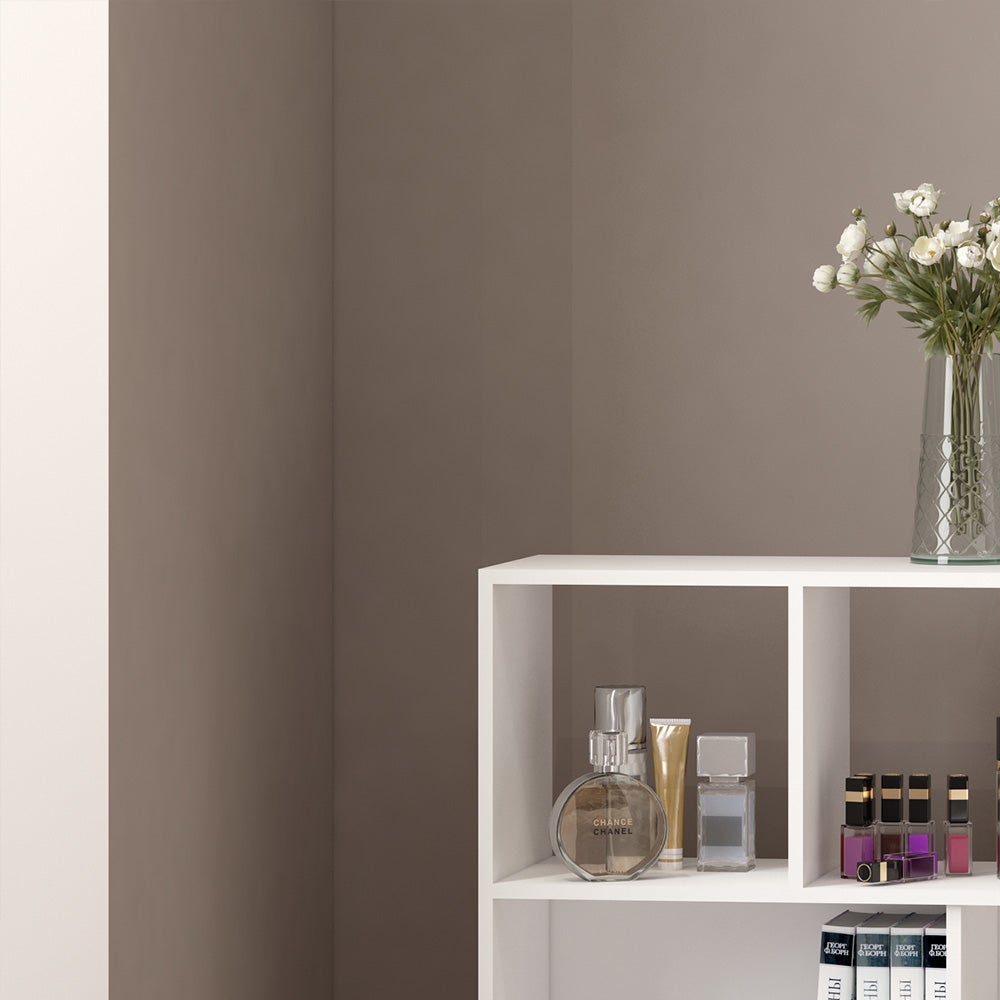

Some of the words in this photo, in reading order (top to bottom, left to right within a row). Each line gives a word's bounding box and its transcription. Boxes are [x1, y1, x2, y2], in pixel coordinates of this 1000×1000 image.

[593, 819, 633, 827] CHANCE
[593, 827, 633, 836] CHANEL
[826, 941, 848, 950] ГЕОРГ
[860, 943, 884, 951] ГЕОРГ
[930, 943, 947, 951] ГЕОР
